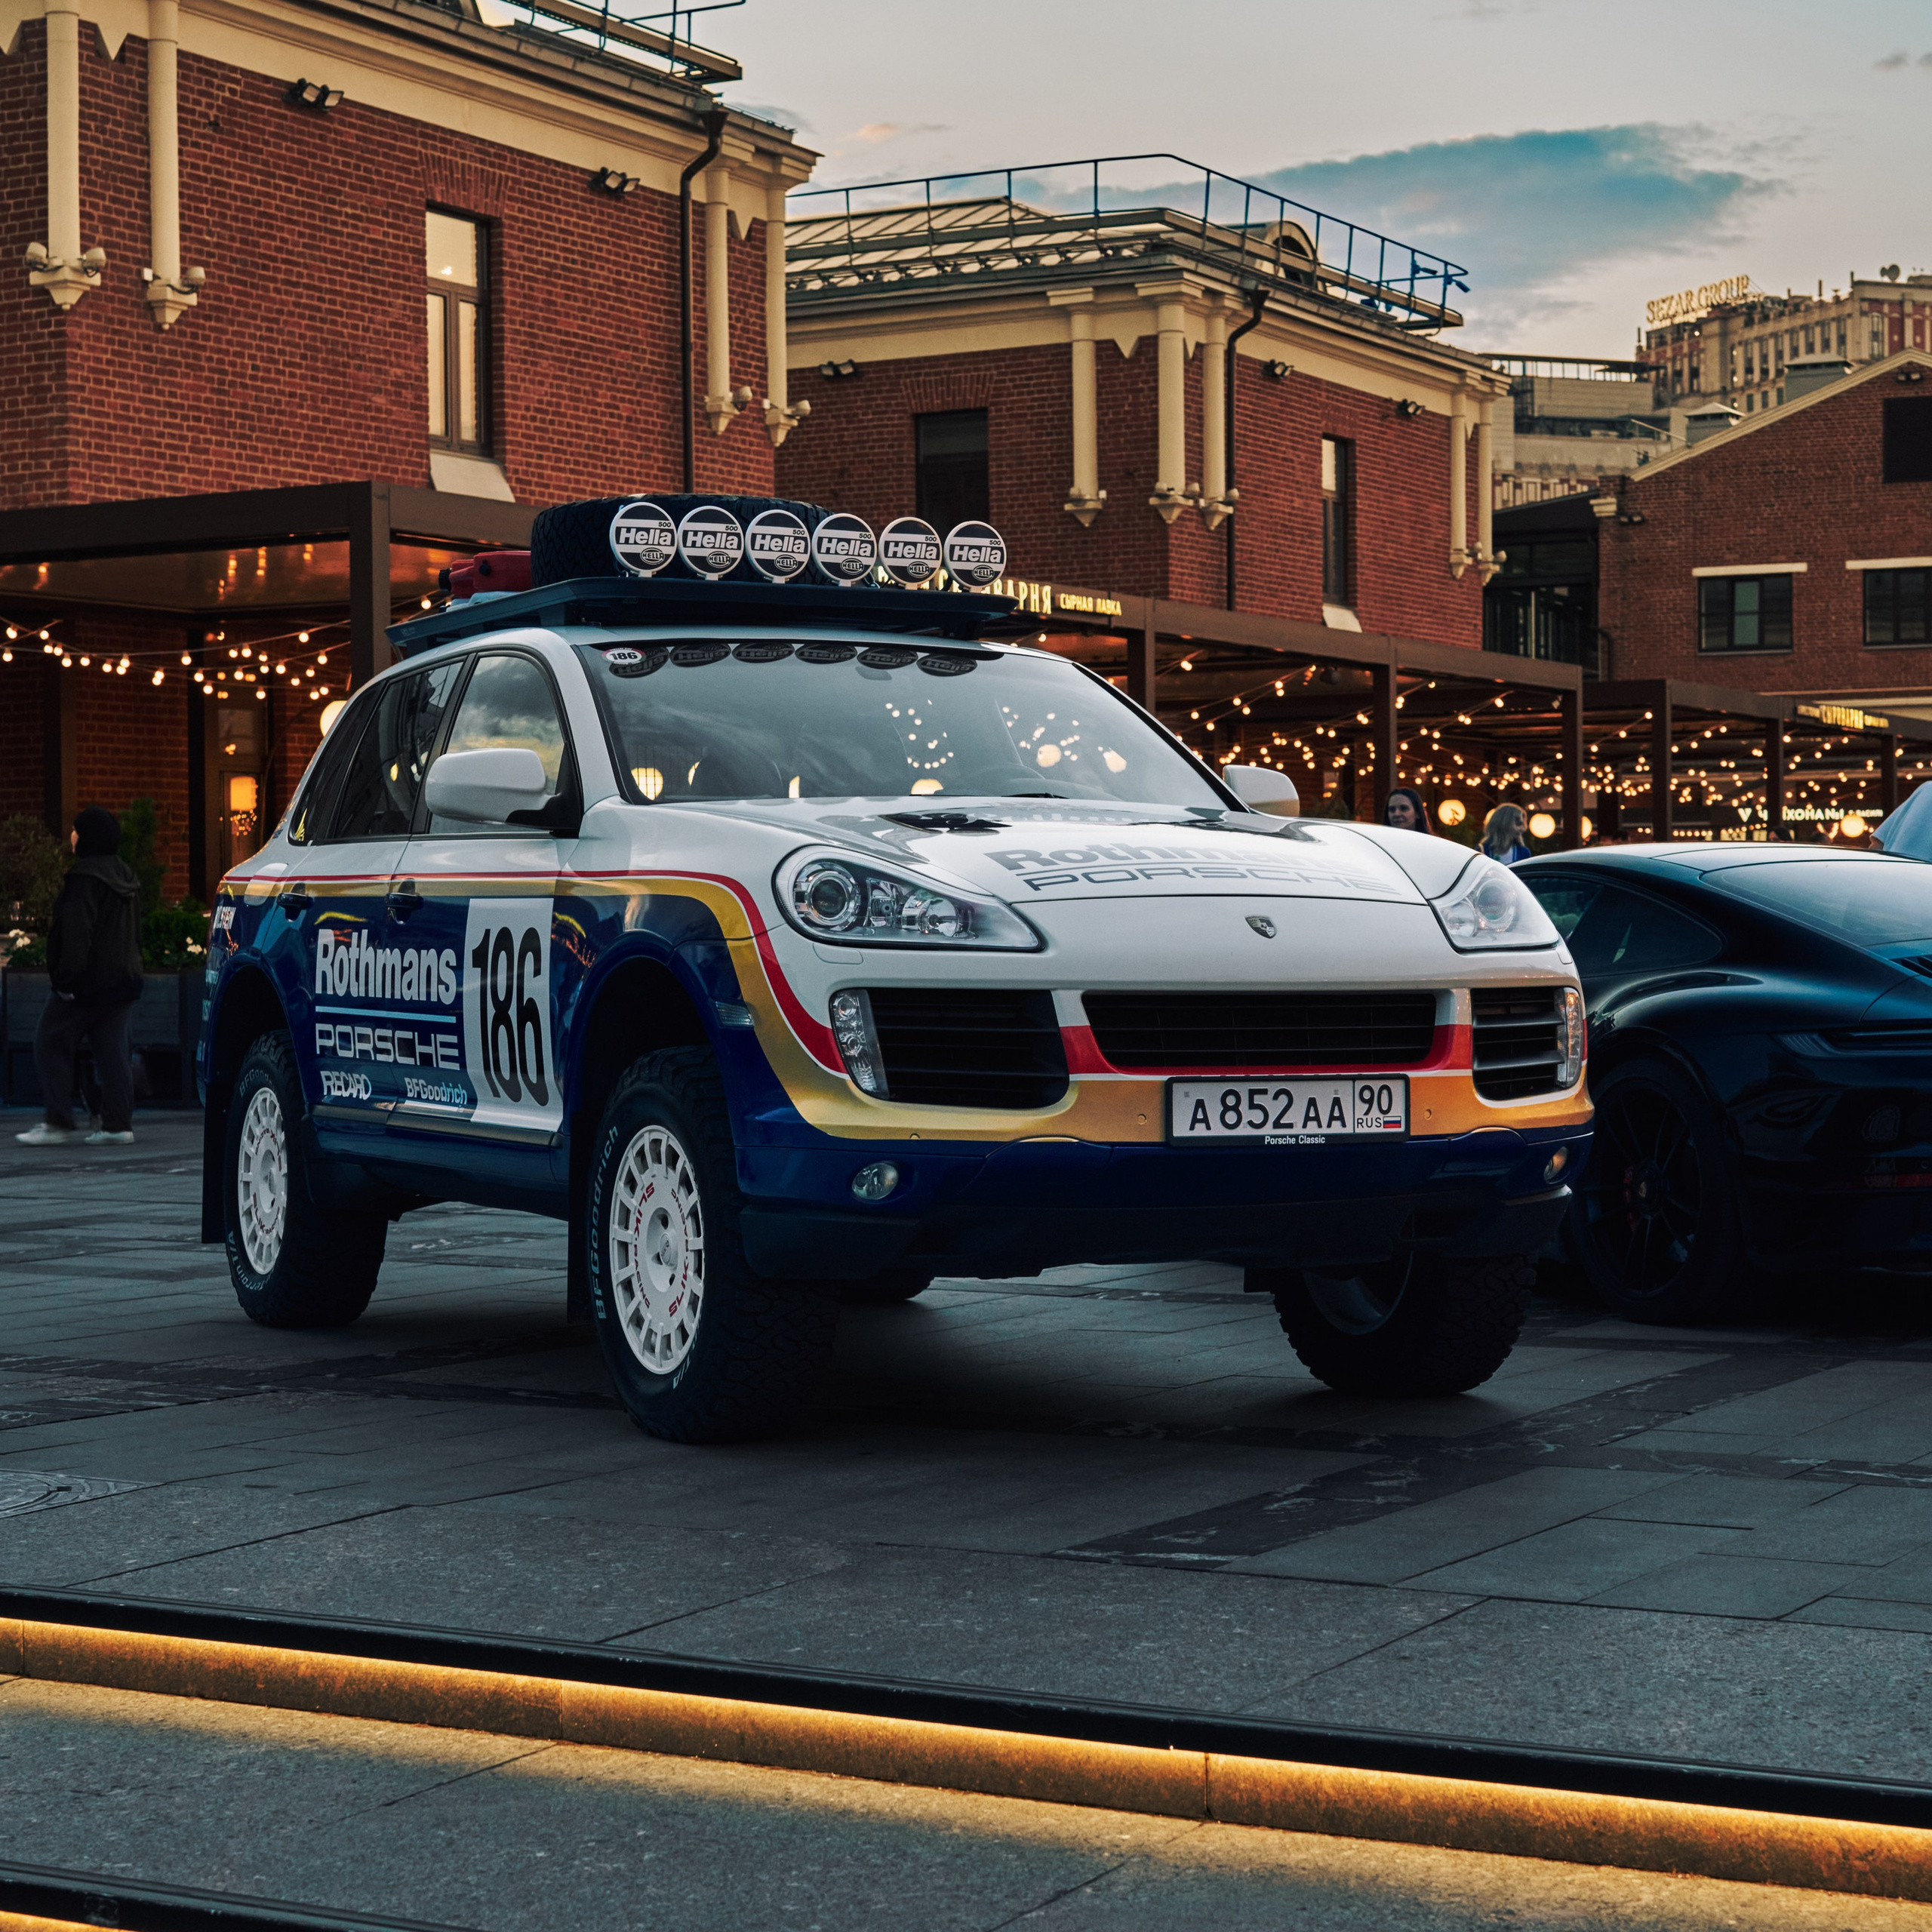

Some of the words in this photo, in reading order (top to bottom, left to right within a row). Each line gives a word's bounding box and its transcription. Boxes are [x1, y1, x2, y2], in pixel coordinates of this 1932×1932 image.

[1697, 274, 1749, 309] GROUP
[619, 528, 672, 546] Hella
[686, 531, 739, 549] Hella
[755, 534, 805, 553] Hella
[820, 538, 872, 556] Hella
[888, 542, 937, 560] Hella
[952, 546, 1001, 563] Hella
[1060, 593, 1094, 612] СЫРНАЯ
[1096, 598, 1122, 616] ЛАВКА
[610, 652, 638, 660] 186
[983, 843, 1367, 874] Rothmans
[1023, 867, 1402, 896] PORSCHE
[315, 928, 457, 1005] Rothmans
[472, 927, 549, 1106] 186
[315, 1023, 460, 1070] PORSCHE
[320, 1071, 372, 1100] RECARO
[404, 1077, 468, 1105] BFGoodrich
[1358, 1084, 1392, 1116] 90
[1356, 1117, 1382, 1128] RUS
[1265, 1135, 1296, 1145] Porsche
[1298, 1134, 1326, 1145] Classic
[589, 1125, 619, 1320] BFGoodrich
